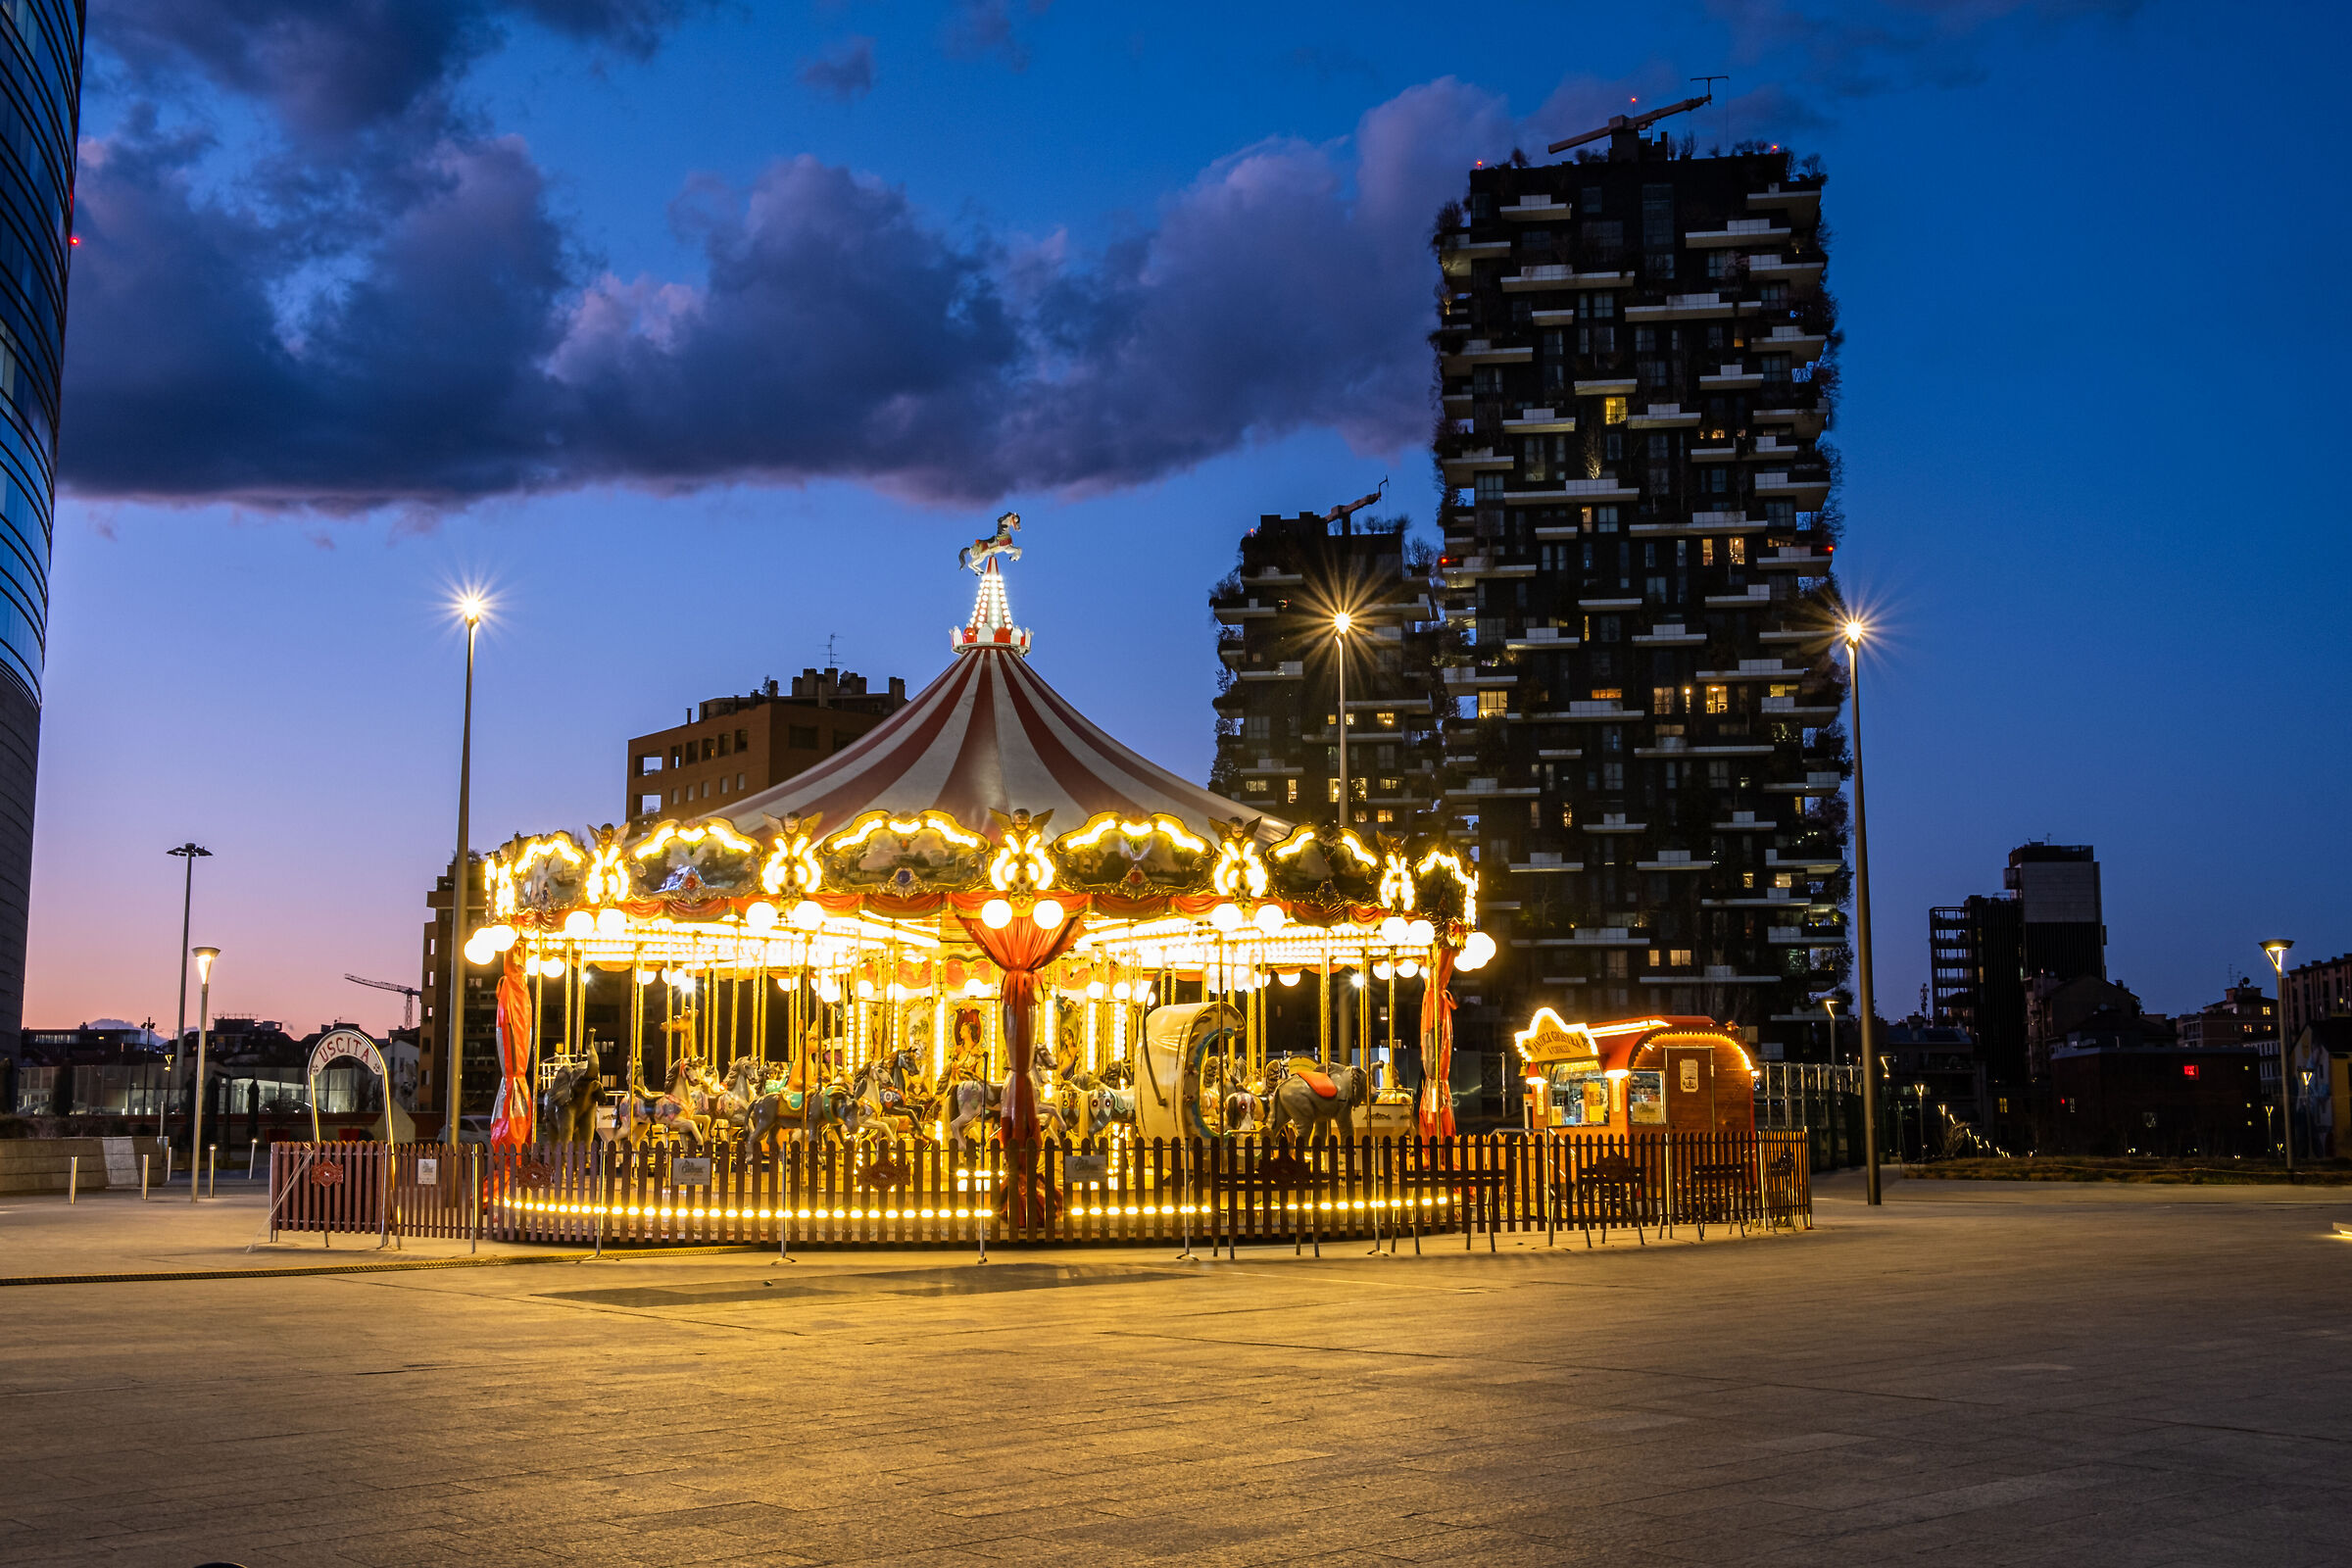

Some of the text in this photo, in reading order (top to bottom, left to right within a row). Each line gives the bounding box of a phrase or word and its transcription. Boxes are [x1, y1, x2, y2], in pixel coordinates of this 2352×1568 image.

[318, 1036, 369, 1063] USCITA
[1533, 1030, 1582, 1053] ANTICA GIOSTRA
